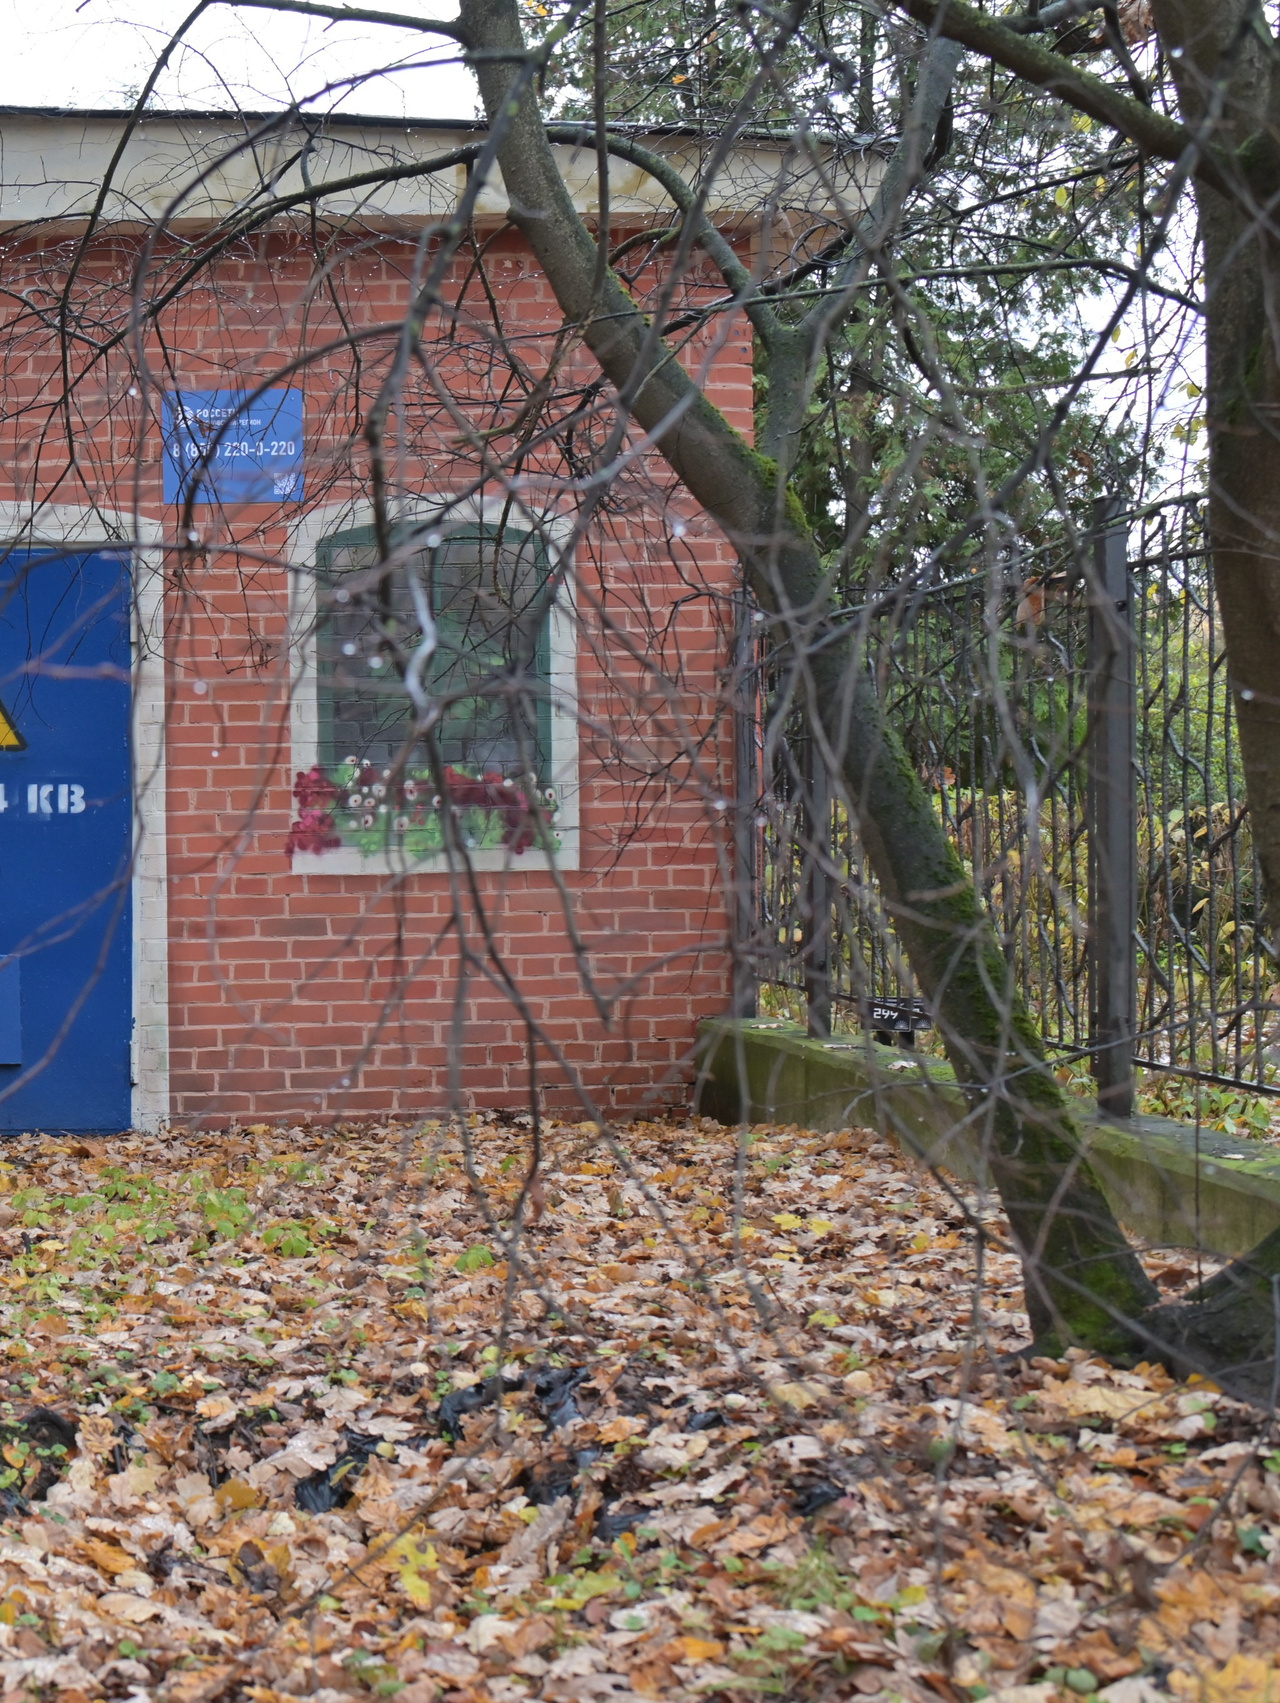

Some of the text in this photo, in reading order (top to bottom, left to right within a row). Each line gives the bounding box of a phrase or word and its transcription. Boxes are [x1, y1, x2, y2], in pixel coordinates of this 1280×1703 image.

[173, 442, 181, 458] 8
[224, 441, 295, 457] 220-0-220
[27, 783, 87, 814] КВ
